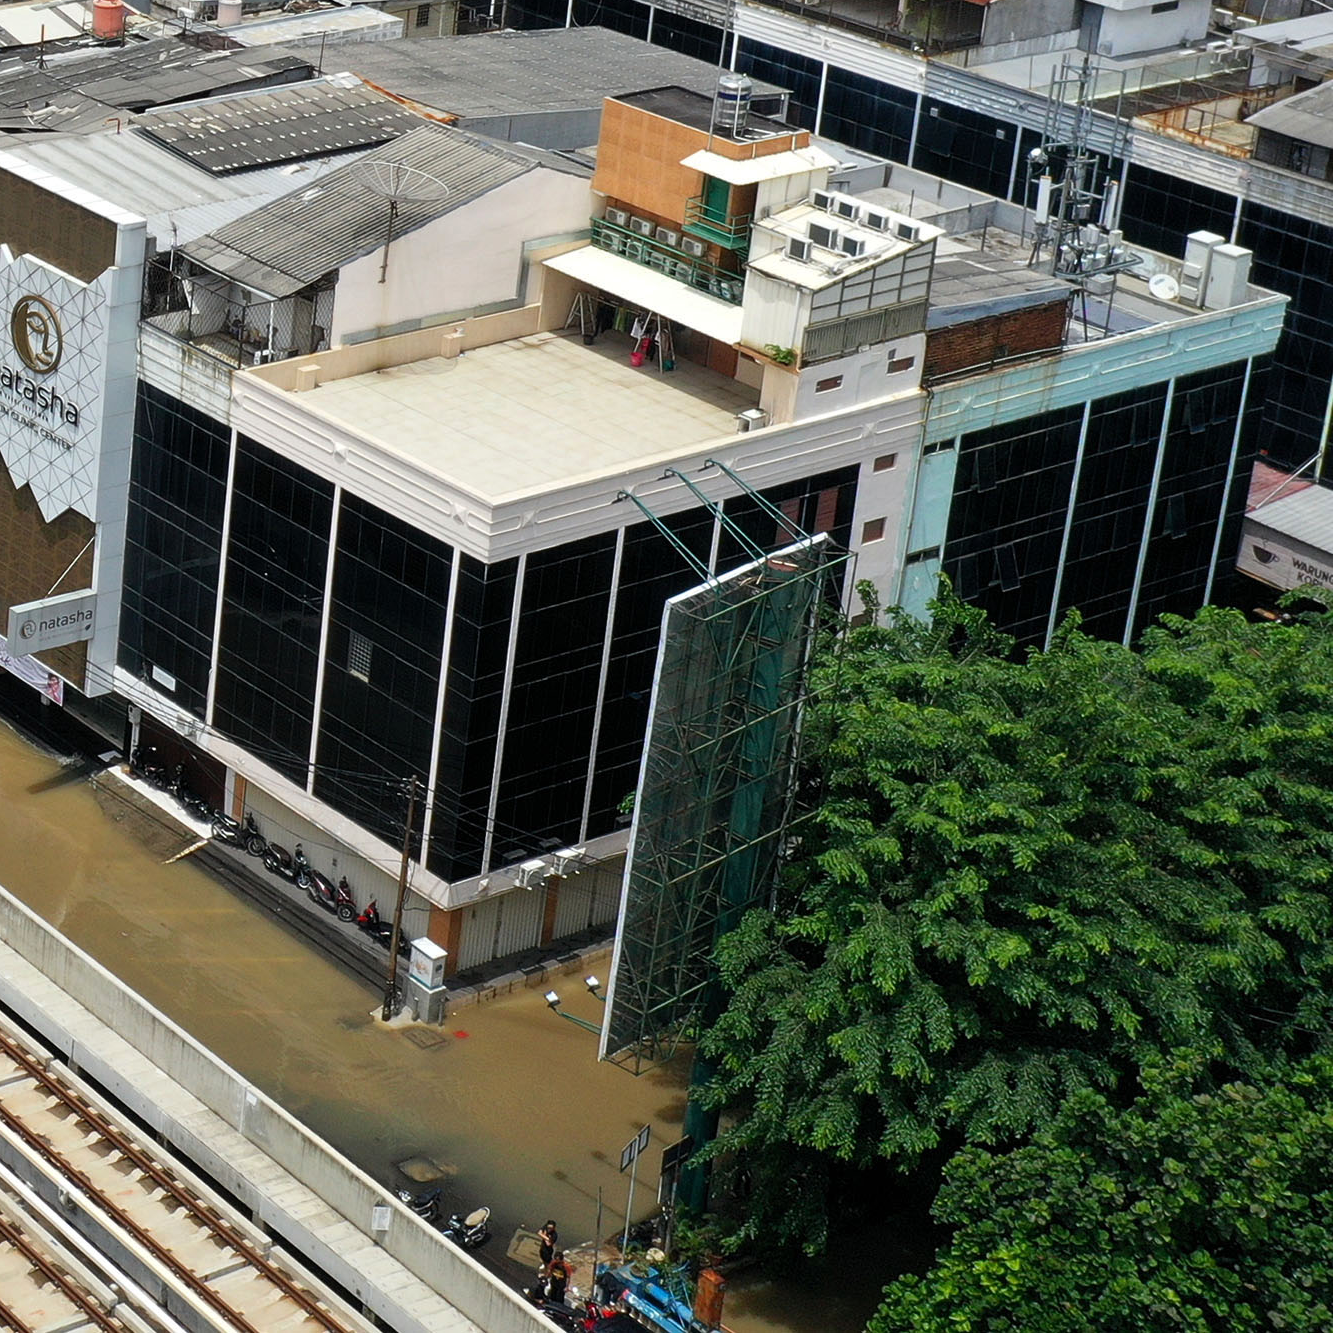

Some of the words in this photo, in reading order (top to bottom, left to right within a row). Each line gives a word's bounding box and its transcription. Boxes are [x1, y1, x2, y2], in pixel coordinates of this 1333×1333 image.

[10, 411, 39, 435] CLINIC
[39, 427, 73, 452] CENTER
[39, 608, 93, 632] natasha
